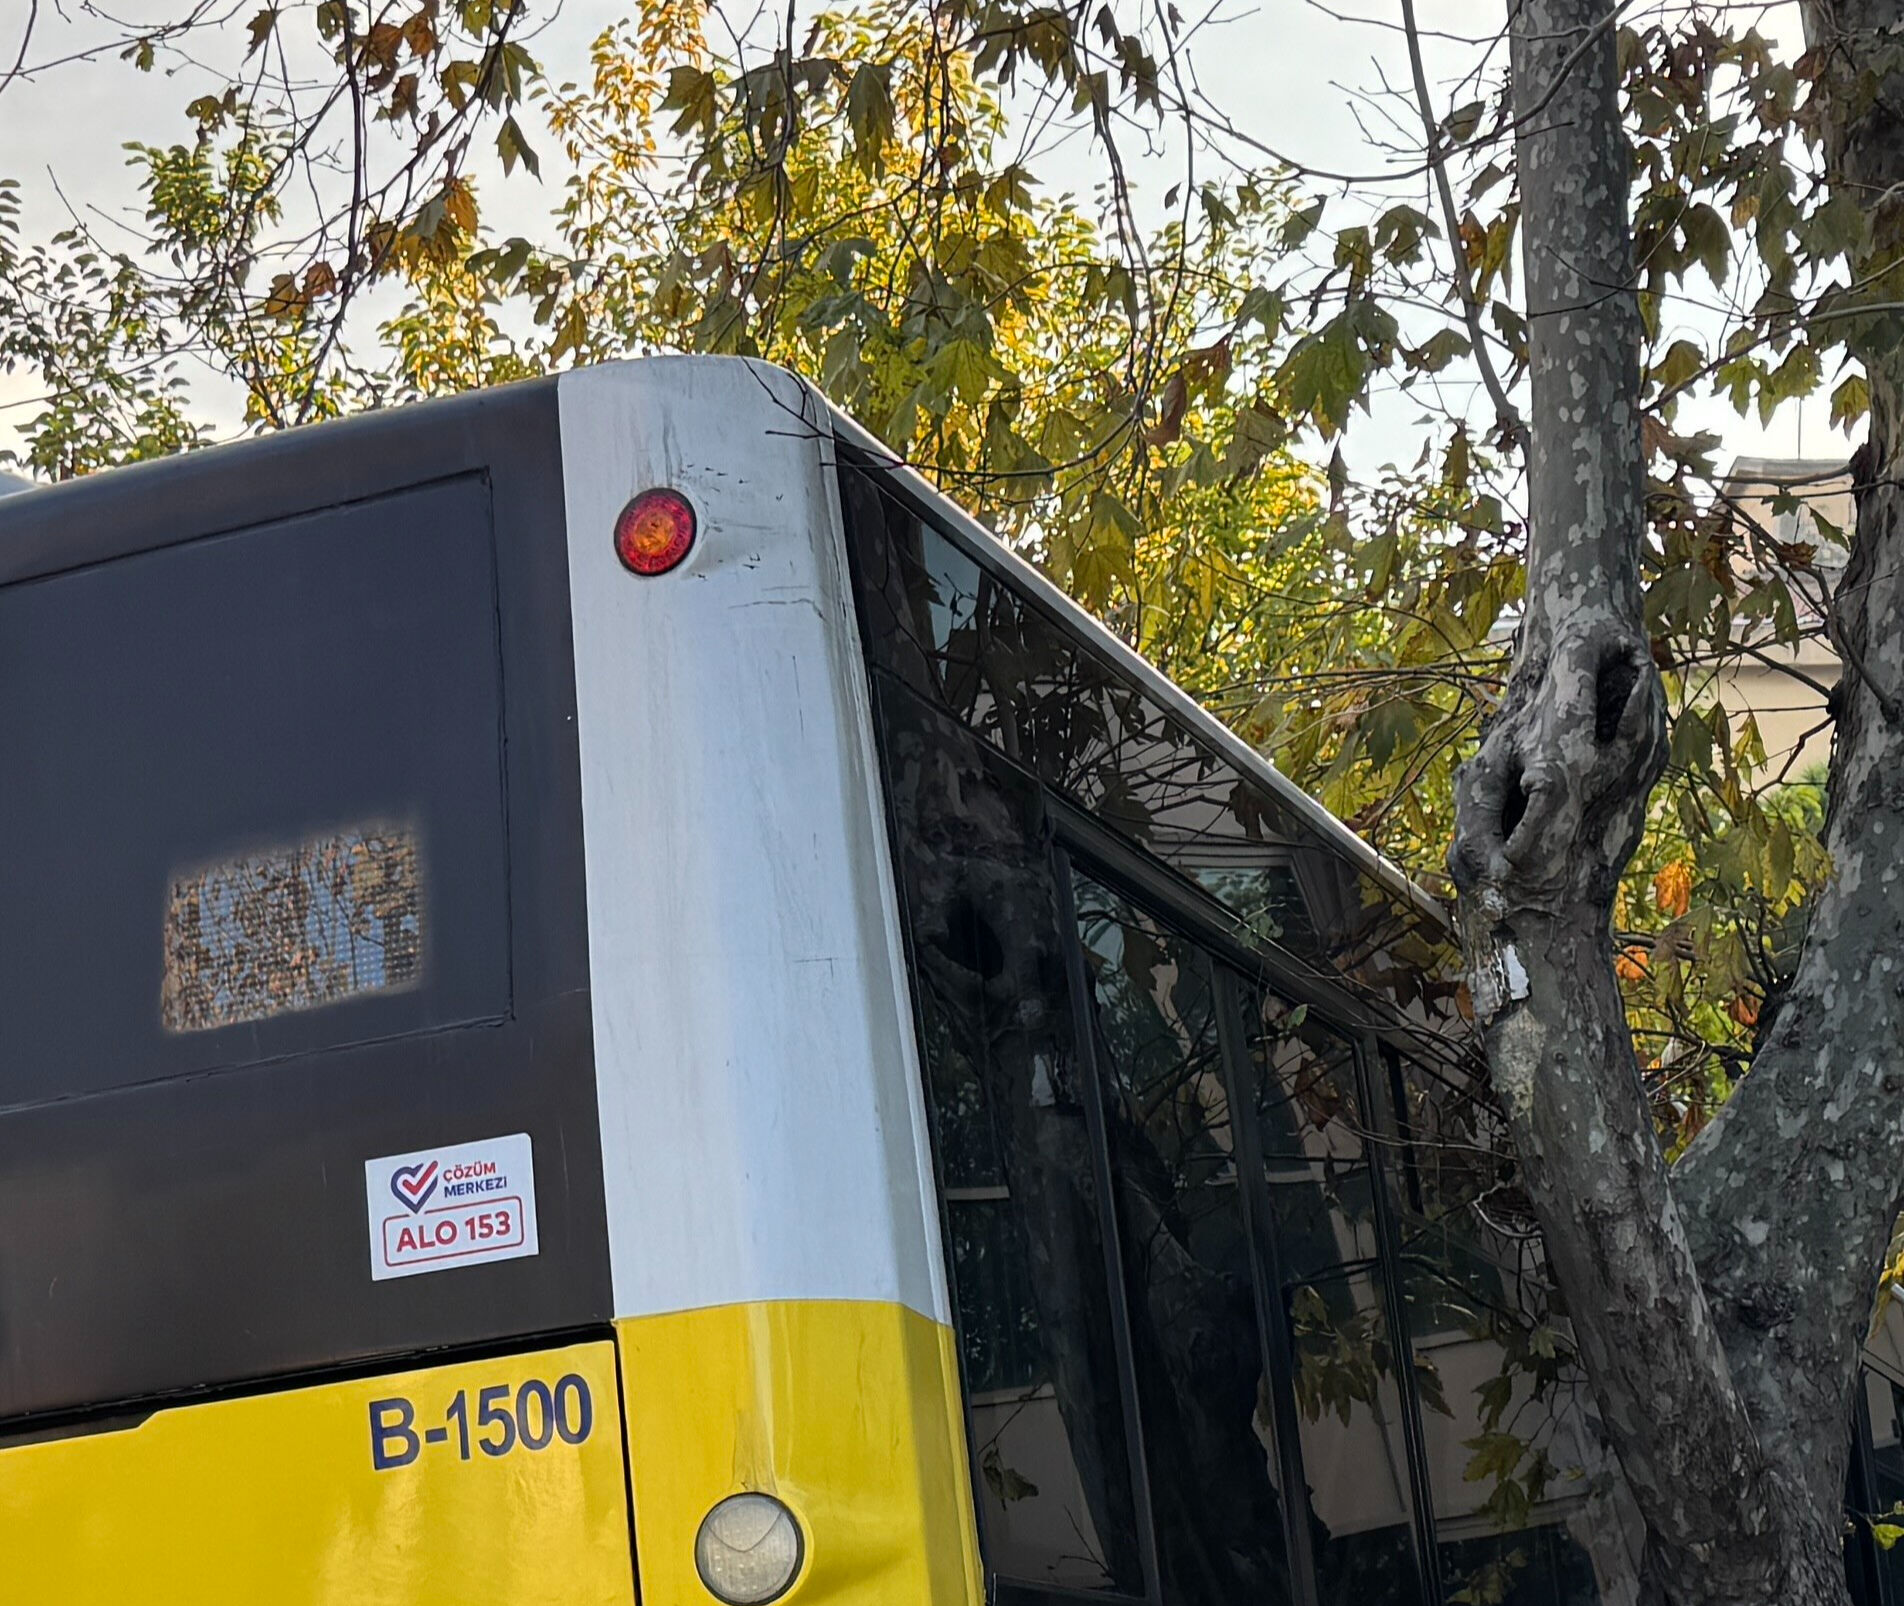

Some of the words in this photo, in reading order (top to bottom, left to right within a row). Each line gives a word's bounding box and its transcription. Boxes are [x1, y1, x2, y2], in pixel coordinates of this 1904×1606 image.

[443, 1160, 496, 1183] ÇÖZÜM
[444, 1176, 507, 1198] MERKEZİ
[396, 1220, 458, 1253] ALO
[465, 1210, 511, 1241] 153
[368, 1373, 593, 1471] B-1500
